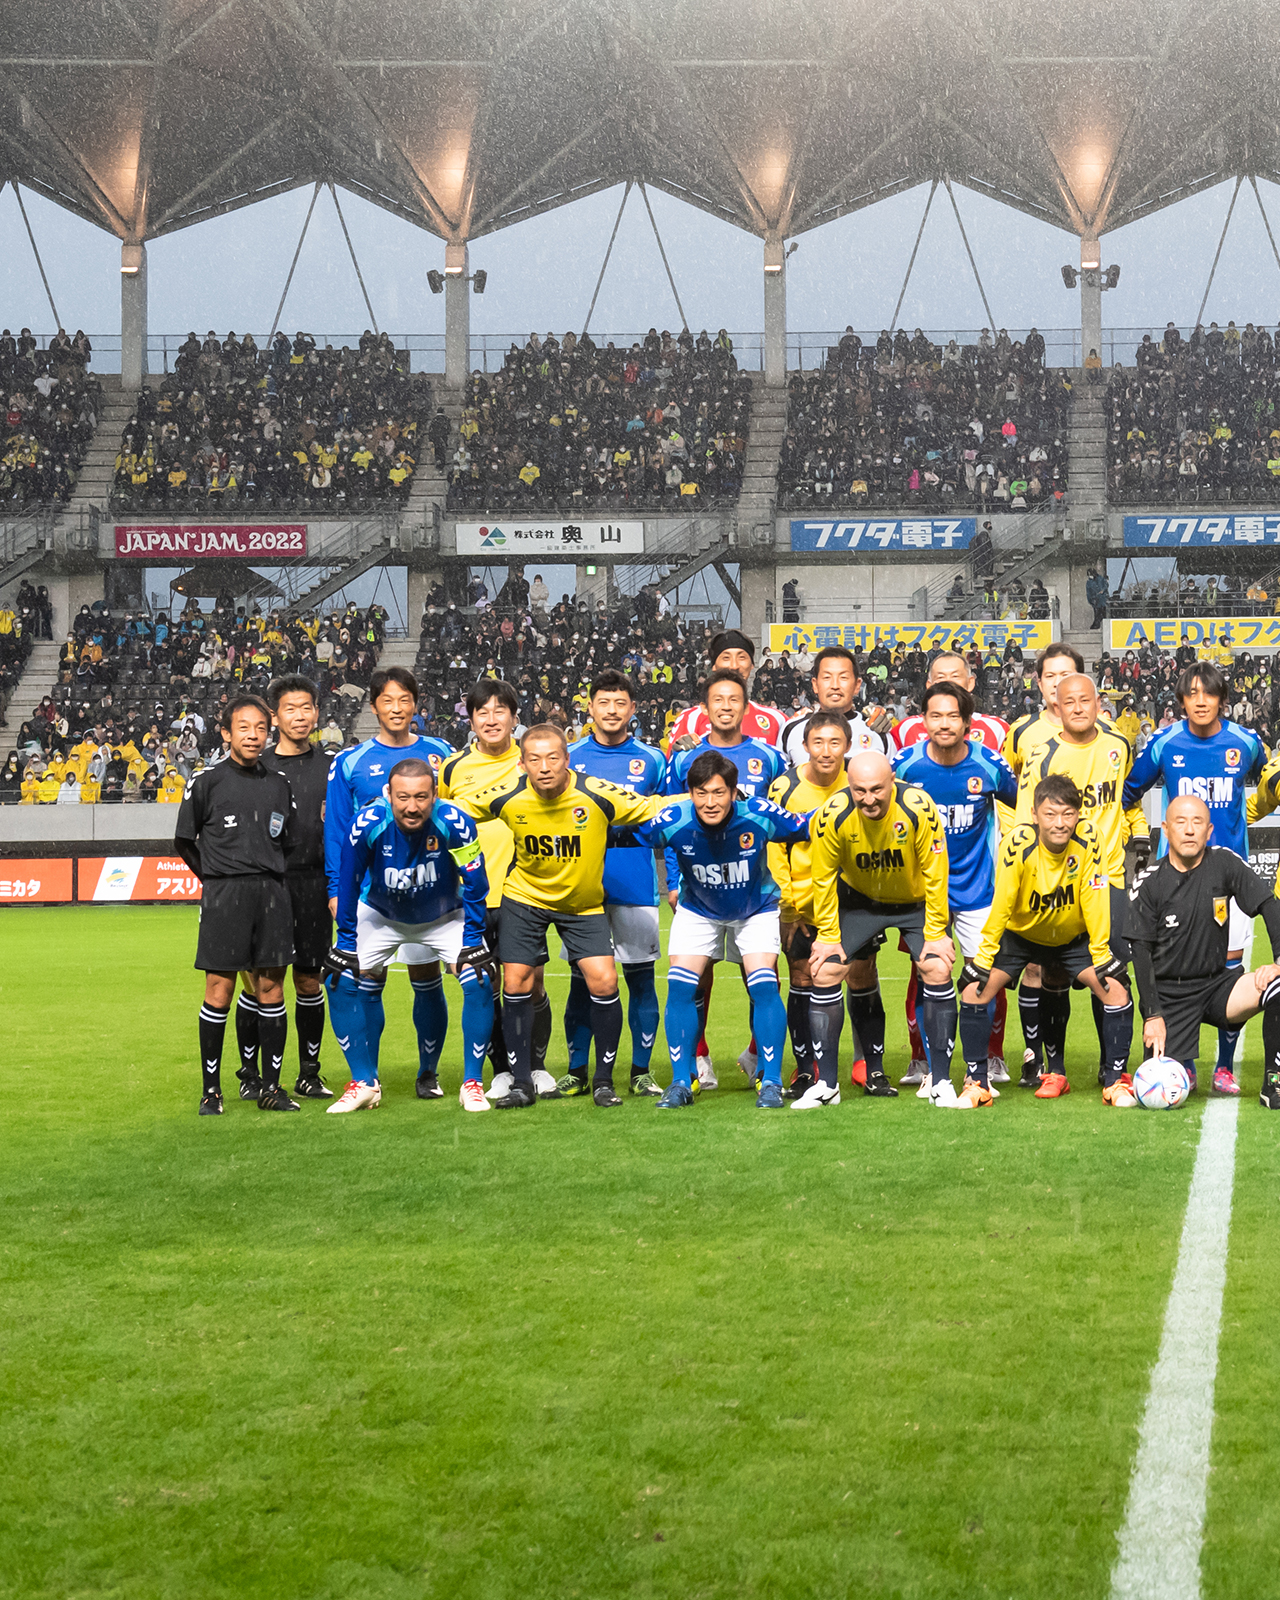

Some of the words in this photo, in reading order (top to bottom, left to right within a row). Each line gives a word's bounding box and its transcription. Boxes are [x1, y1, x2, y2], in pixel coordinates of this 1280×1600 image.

[119, 531, 197, 553] JAPAN
[194, 531, 247, 553] JAM
[249, 531, 303, 550] 2022
[804, 520, 963, 548] フクダ電子
[156, 877, 203, 895] アスリ
